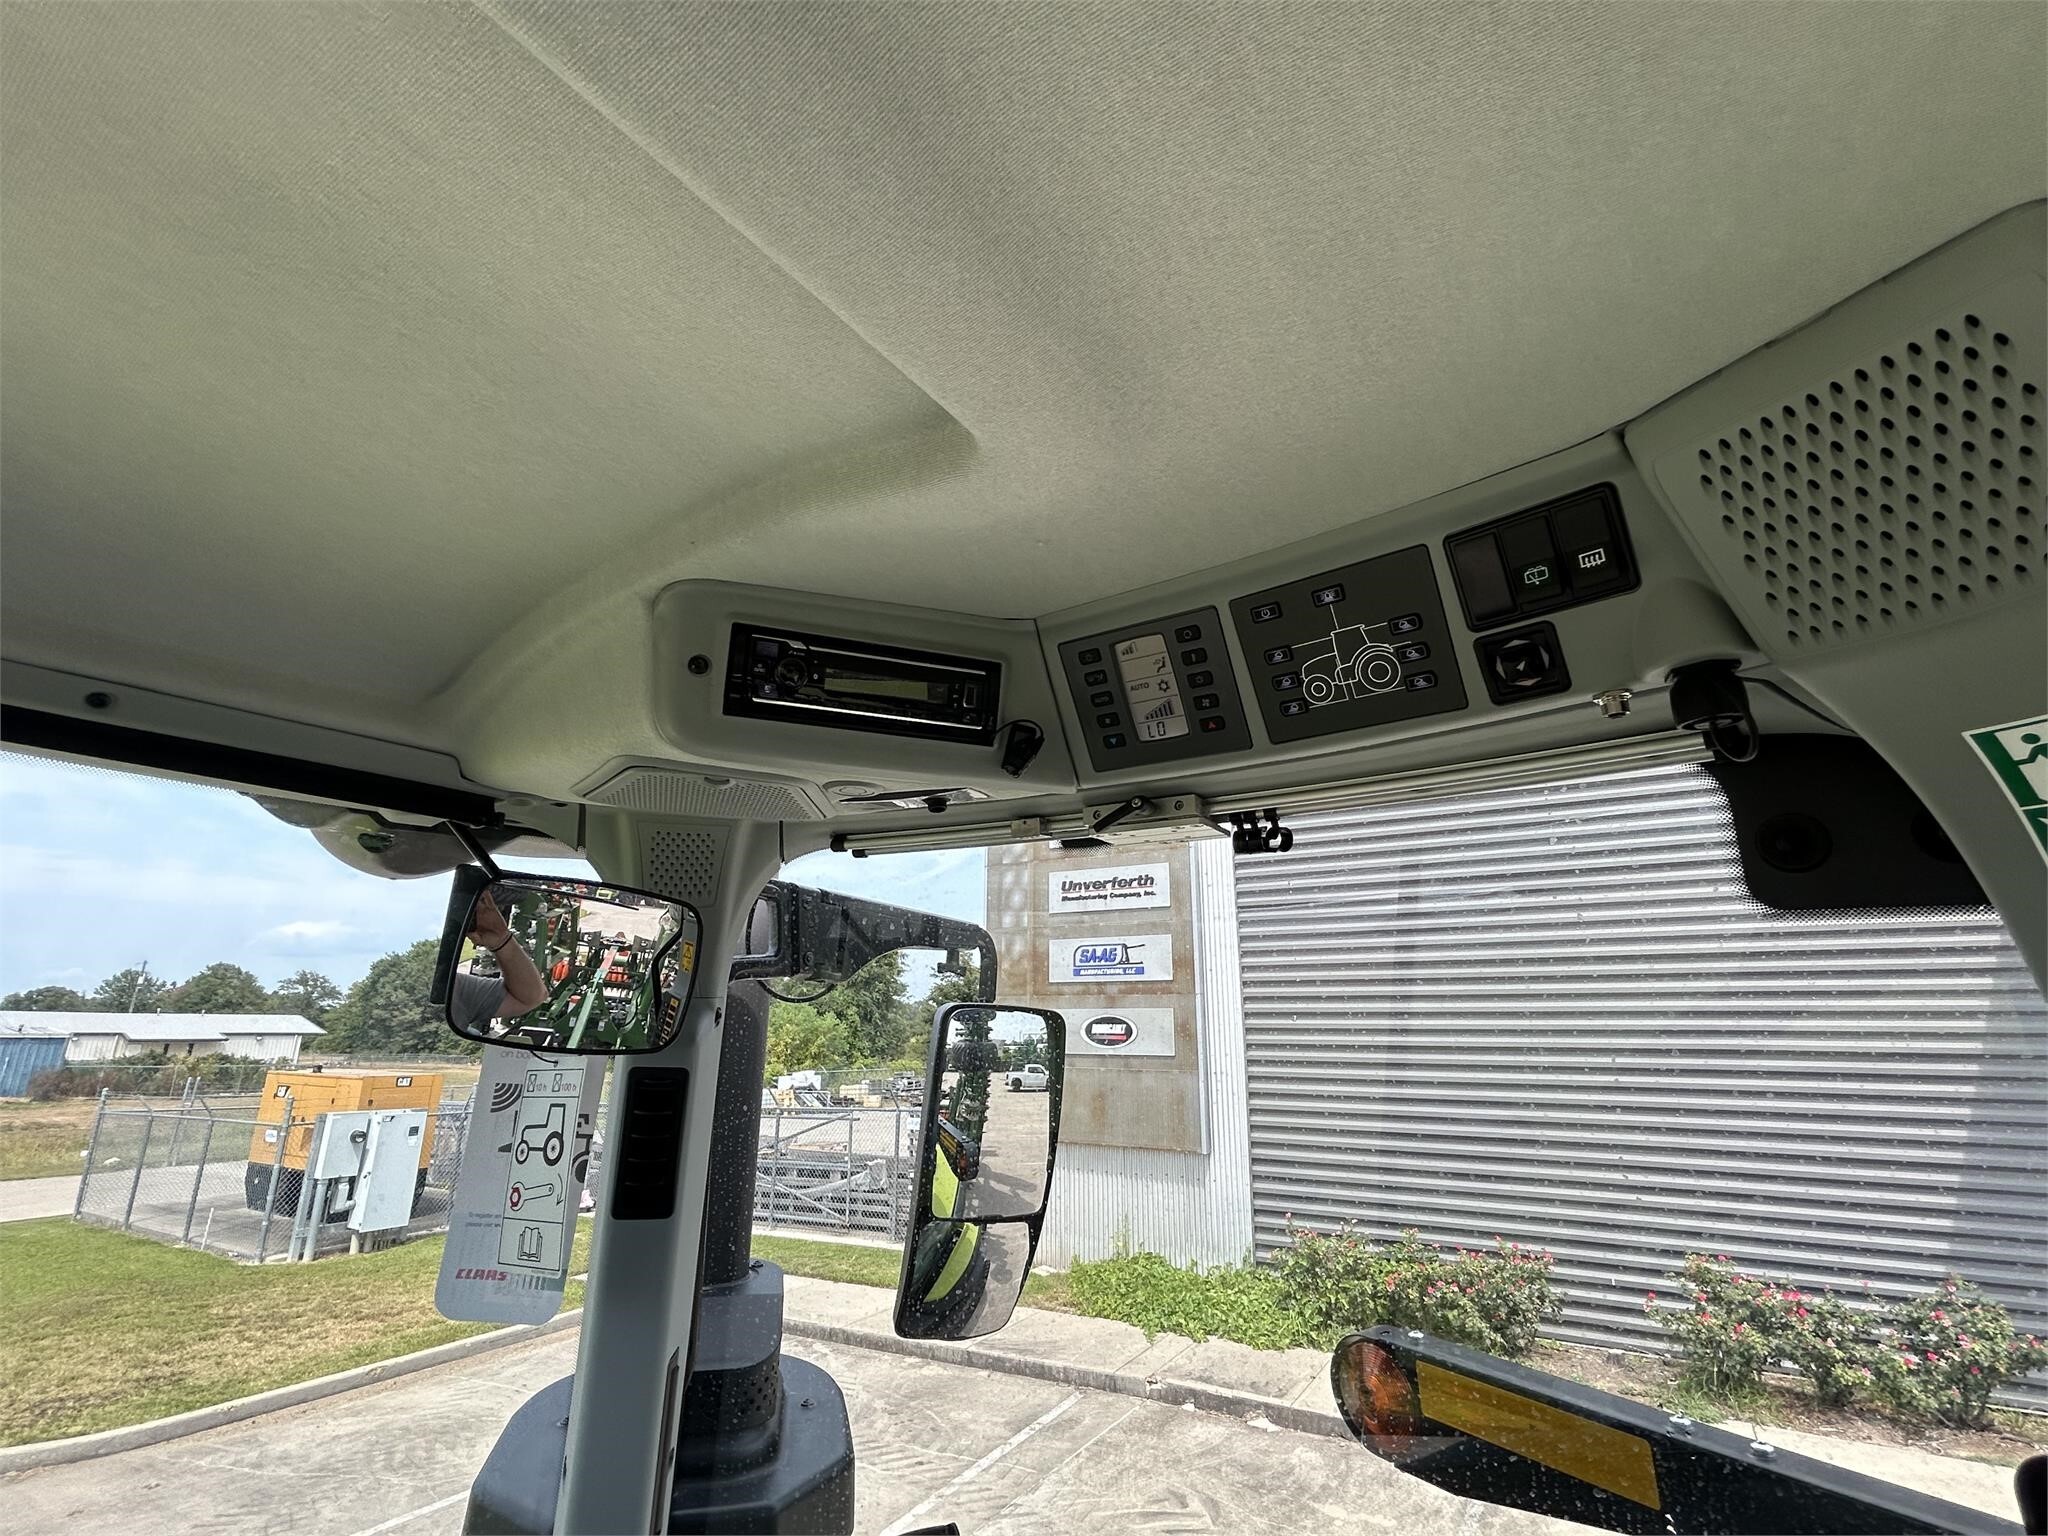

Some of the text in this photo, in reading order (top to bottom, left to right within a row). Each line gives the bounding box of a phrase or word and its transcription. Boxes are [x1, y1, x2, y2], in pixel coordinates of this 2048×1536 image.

[1130, 682, 1150, 692] AUTO
[397, 1077, 411, 1087] CAT
[455, 1268, 508, 1281] CLAAS
